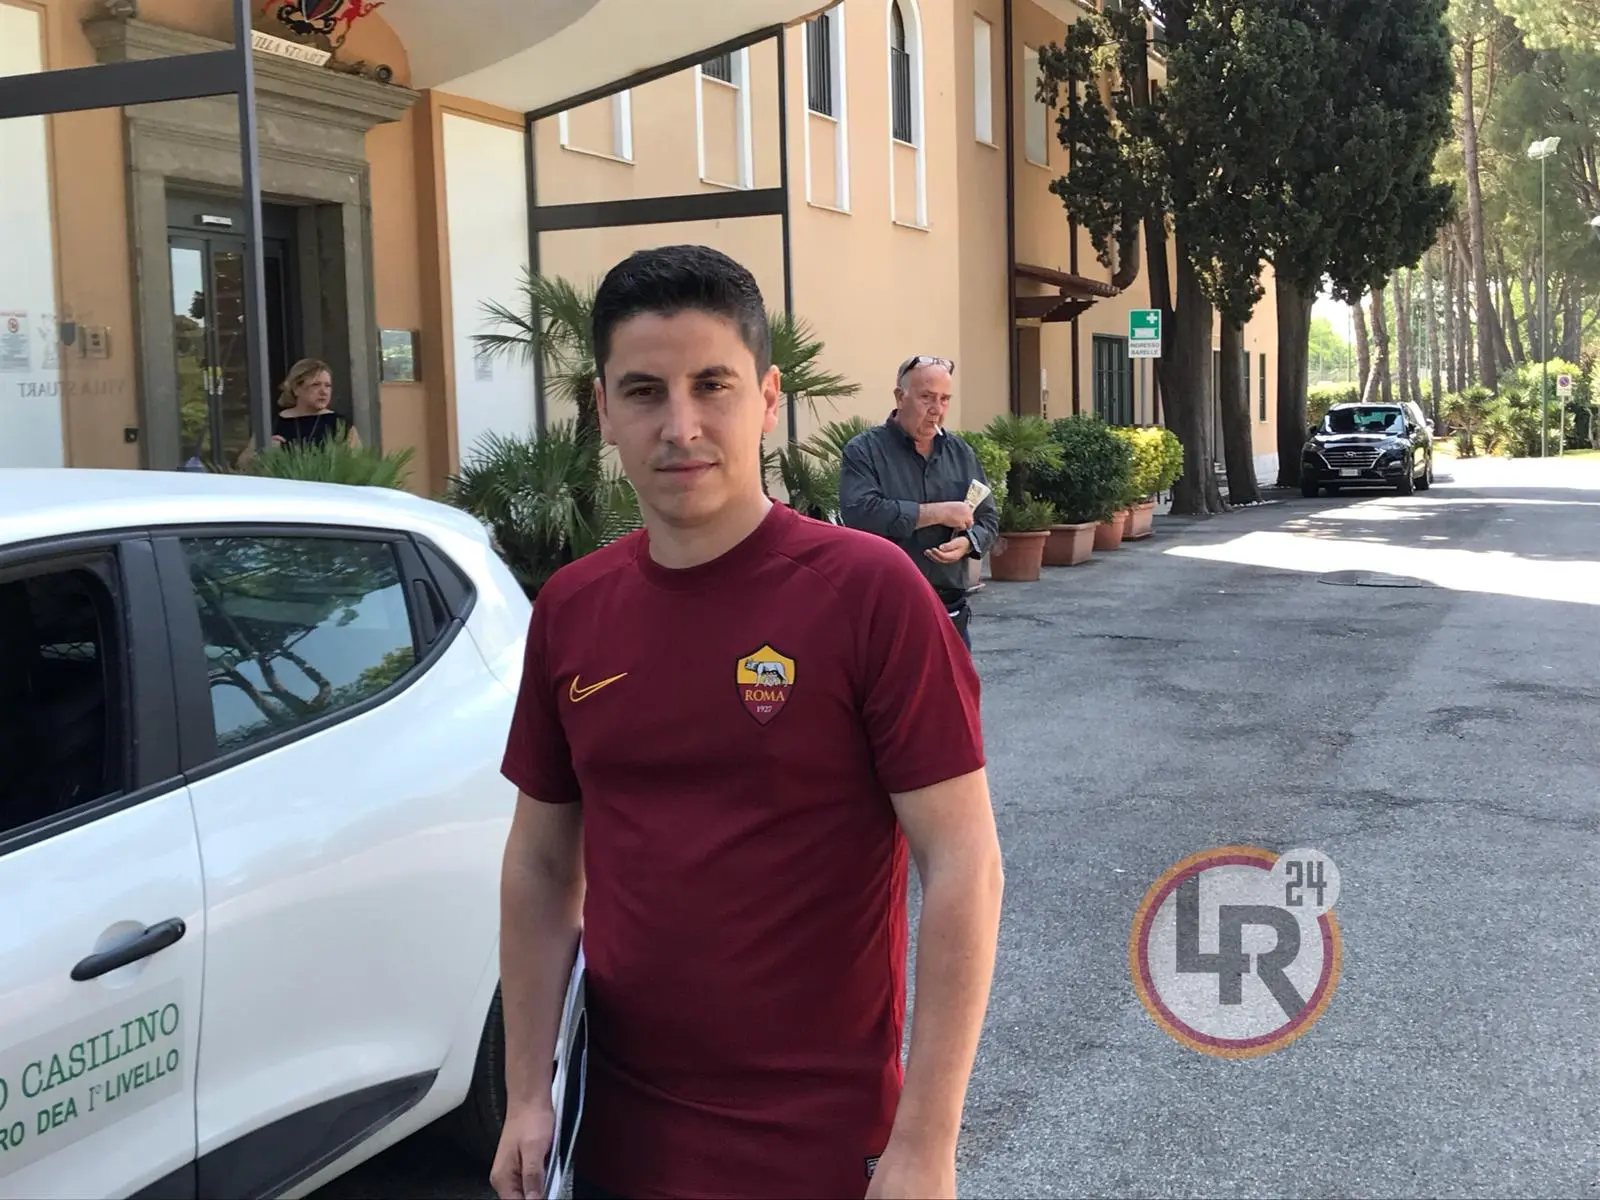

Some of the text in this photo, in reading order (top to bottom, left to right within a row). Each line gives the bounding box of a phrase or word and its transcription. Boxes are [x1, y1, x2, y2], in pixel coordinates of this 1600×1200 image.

[284, 44, 326, 64] STUART
[744, 689, 785, 702] ROMA
[756, 705, 773, 713] 1927
[21, 1002, 179, 1098] CASILINO
[37, 1096, 78, 1136] DEA
[105, 1048, 179, 1102] LIVELLO
